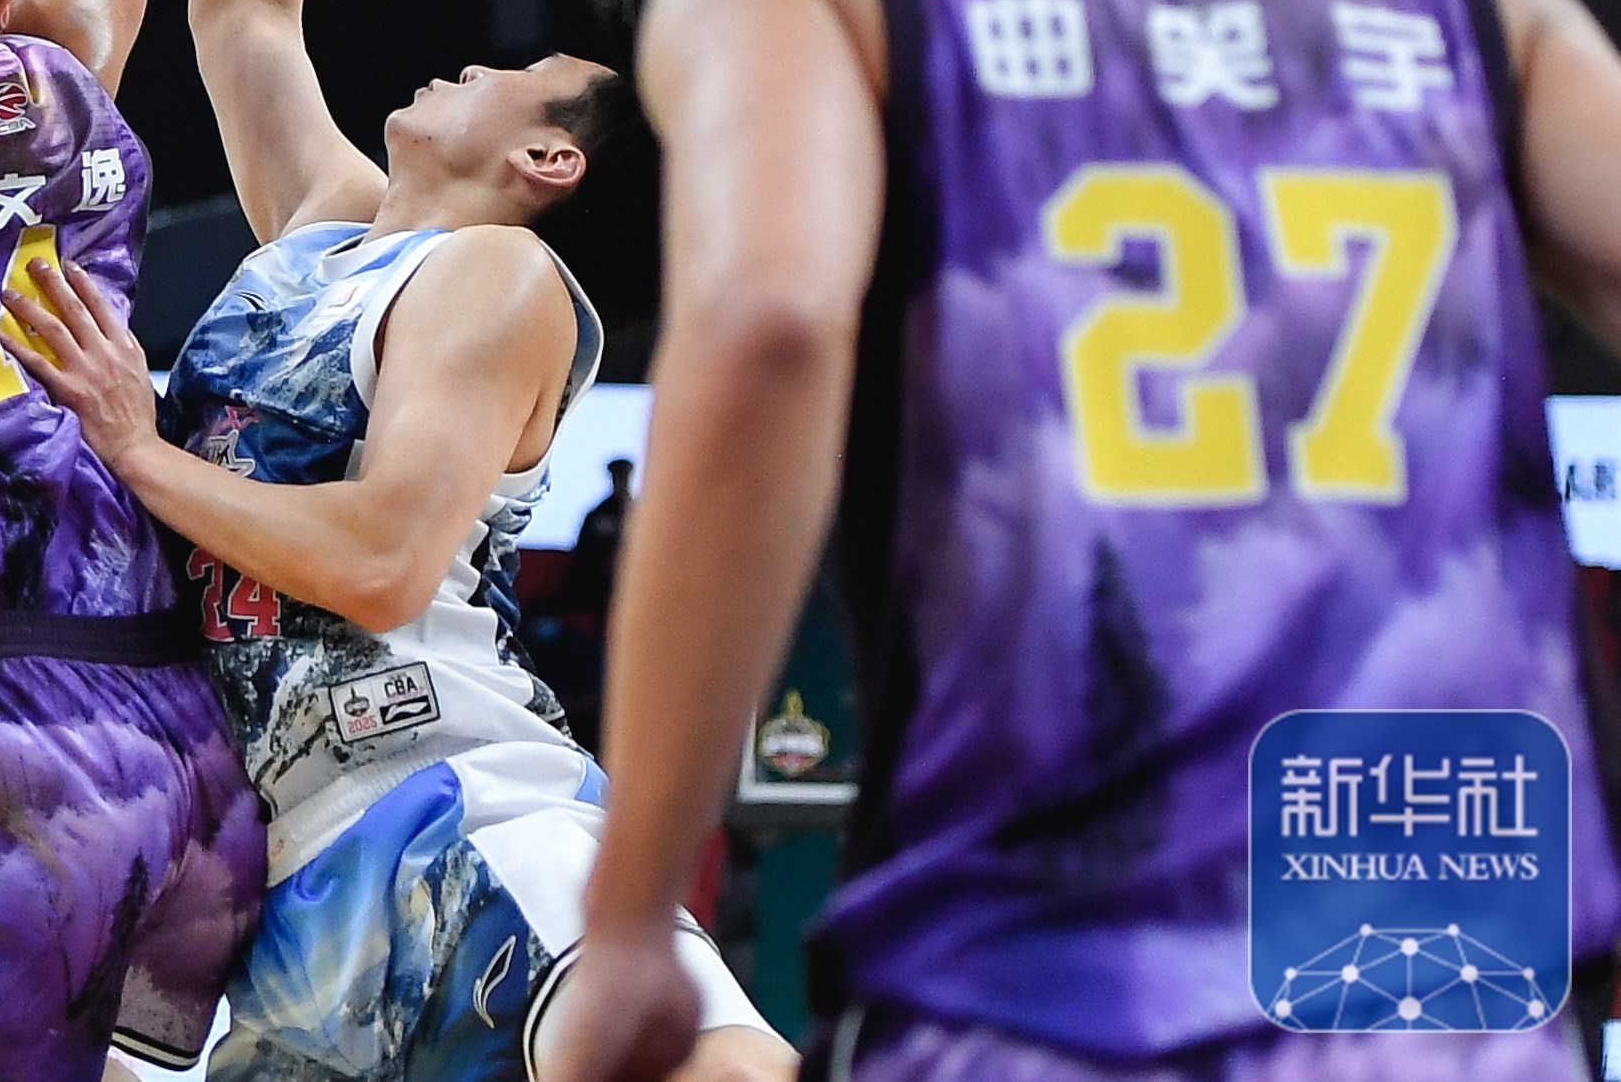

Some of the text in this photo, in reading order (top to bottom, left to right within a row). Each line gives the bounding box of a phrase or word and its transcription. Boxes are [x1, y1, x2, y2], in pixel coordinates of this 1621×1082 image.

[1043, 162, 1459, 506] 27
[186, 548, 281, 642] 24
[384, 676, 418, 698] CBA
